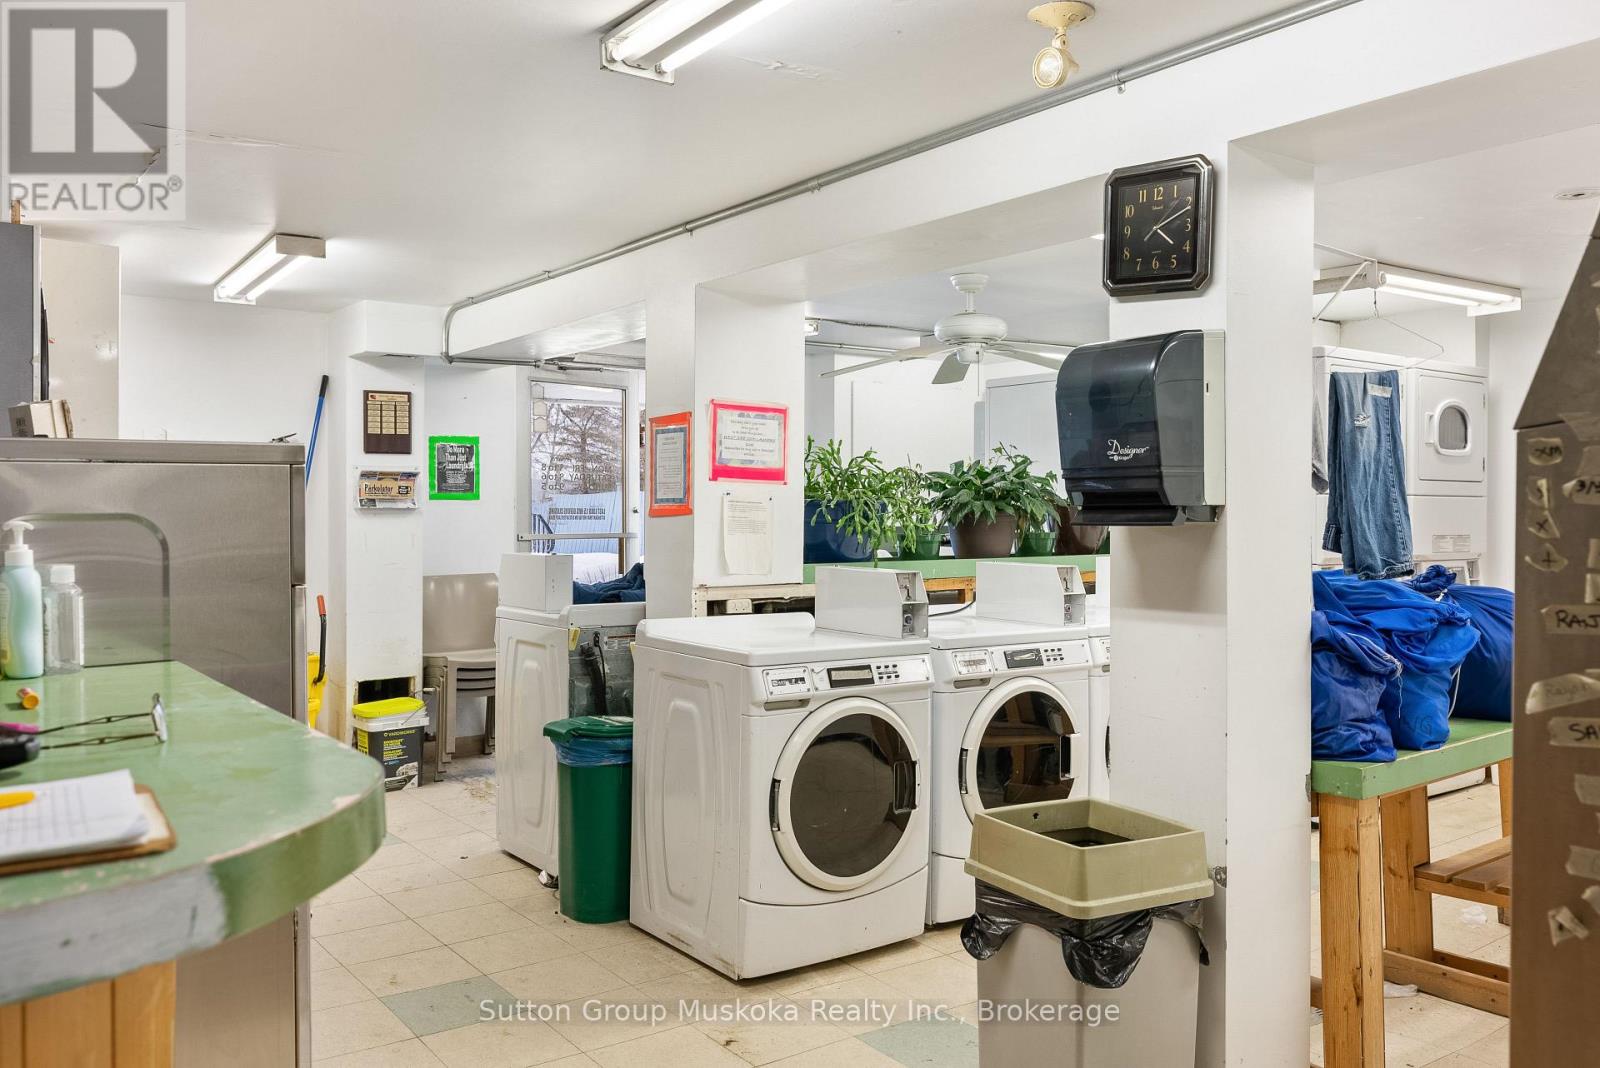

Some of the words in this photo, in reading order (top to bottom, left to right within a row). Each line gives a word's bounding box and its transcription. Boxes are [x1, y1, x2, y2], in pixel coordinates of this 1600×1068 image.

[1138, 189, 1147, 203] 11
[1153, 186, 1163, 200] 12
[1173, 184, 1177, 198] 1
[1186, 196, 1192, 208] 2
[1124, 204, 1134, 218] 10
[1124, 225, 1131, 239] 9
[1185, 219, 1191, 232] 3
[1183, 240, 1191, 253] 4
[1123, 247, 1130, 261] 8
[1136, 258, 1142, 272] 7
[1152, 255, 1159, 269] 6
[1170, 254, 1177, 269] 5
[1107, 438, 1150, 458] Designer
